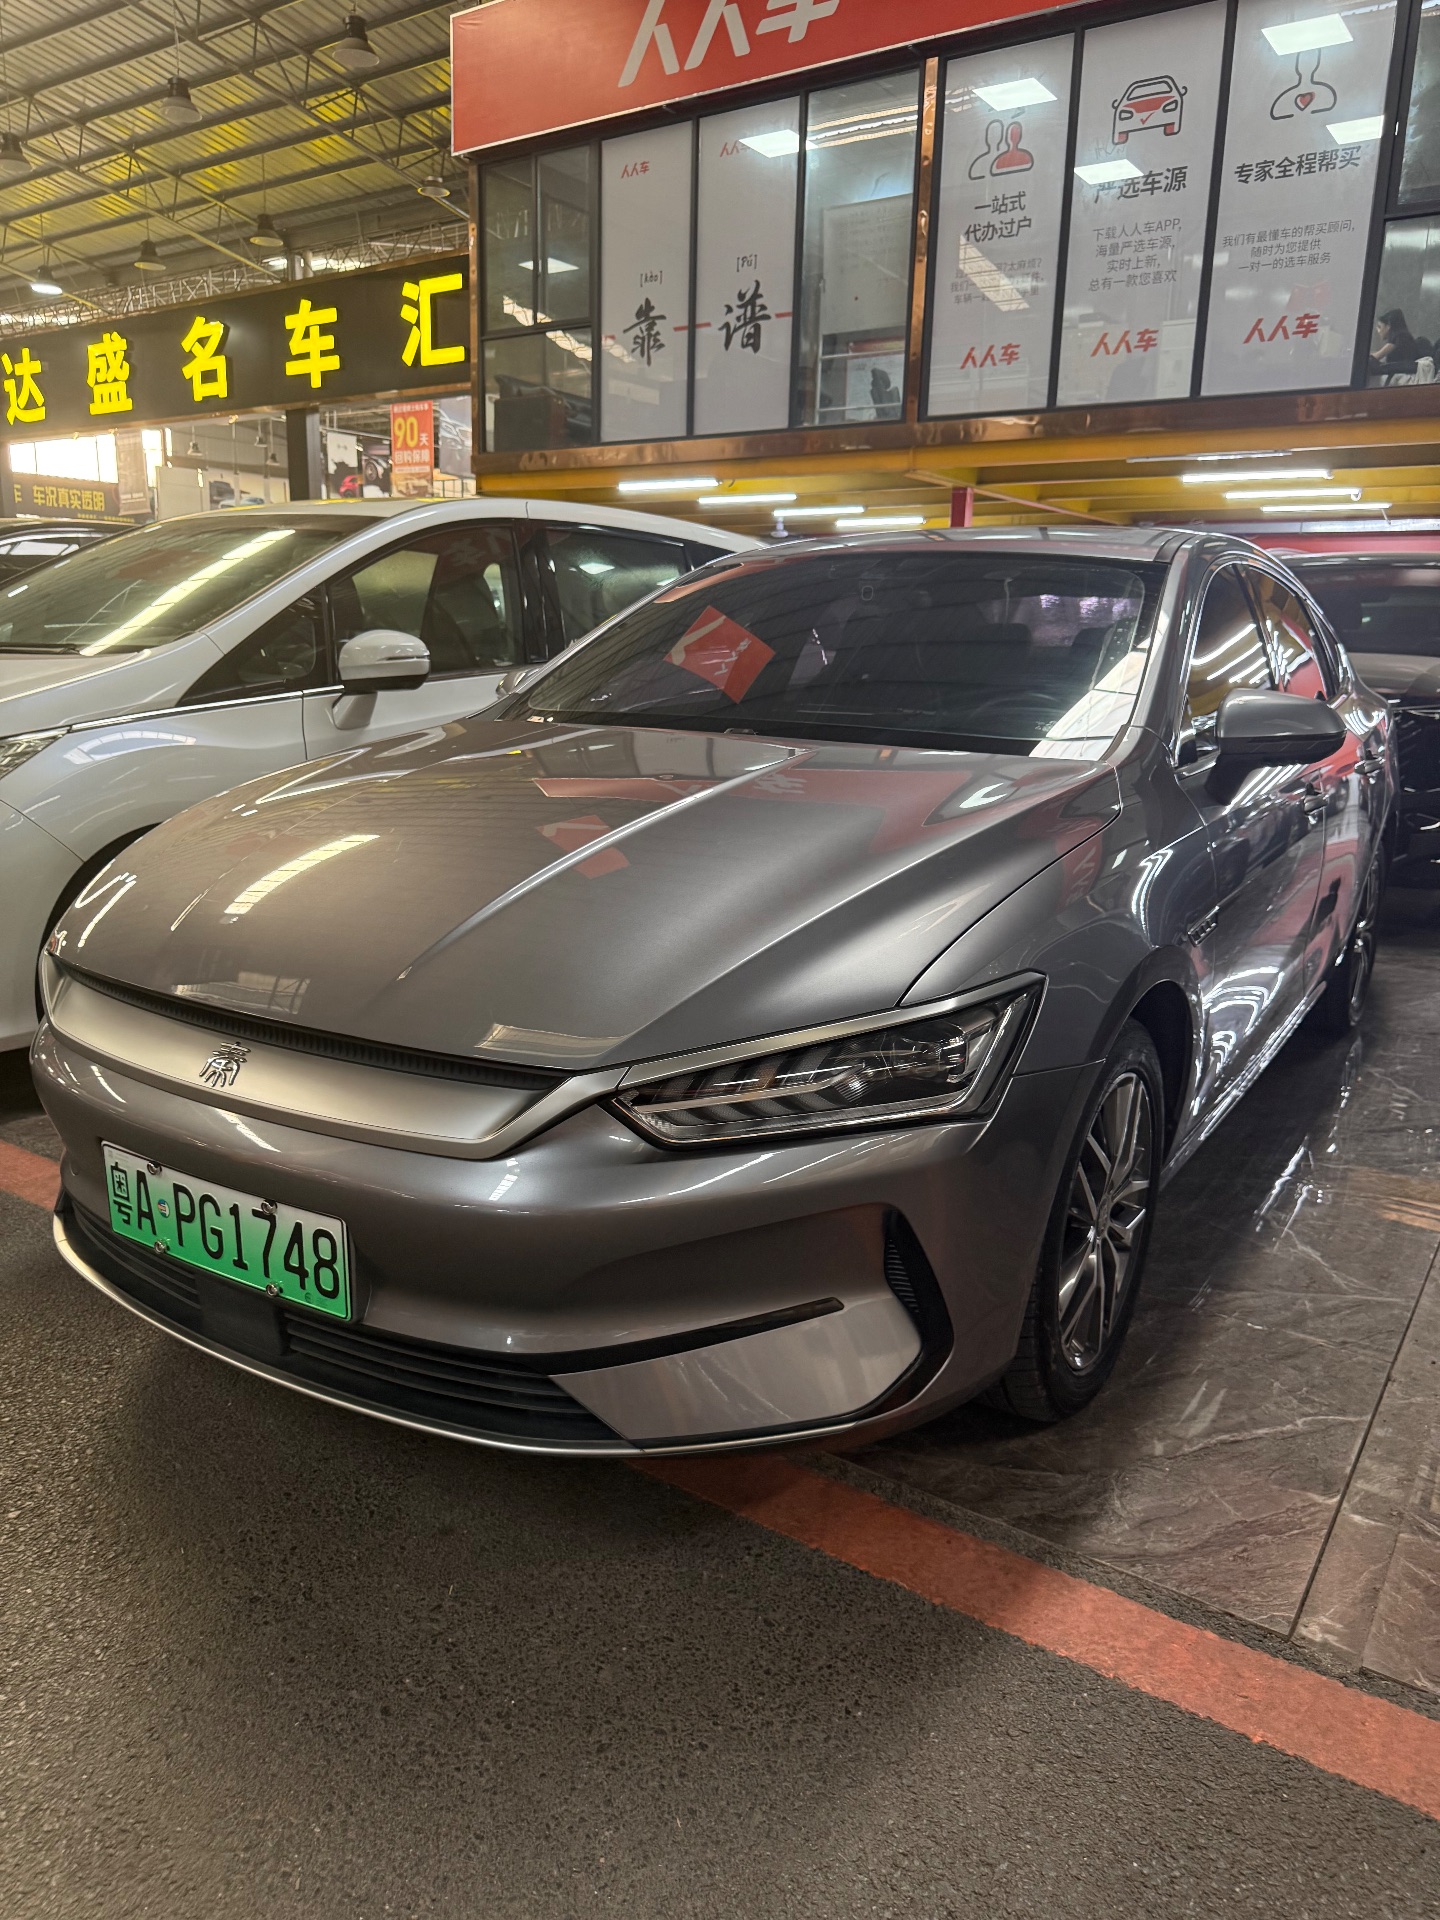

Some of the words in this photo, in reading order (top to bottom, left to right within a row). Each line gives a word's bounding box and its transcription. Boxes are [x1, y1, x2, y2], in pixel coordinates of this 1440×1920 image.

[621, 160, 651, 179] 人人车
[1234, 145, 1361, 184] 专家全程帮买
[974, 190, 1026, 214] 一站式
[964, 215, 1032, 243] 代办过户
[1238, 252, 1332, 273] 一对一的选车服务
[1250, 239, 1322, 258] 随时为您提供
[1088, 270, 1178, 292] 总有一款您喜欢
[717, 279, 772, 354] 谱
[1243, 313, 1321, 344] 人人车
[622, 297, 667, 367] 靠
[1090, 328, 1159, 357] 人人车
[1, 272, 466, 426] 达盛名车汇
[960, 342, 1022, 370] 人人车
